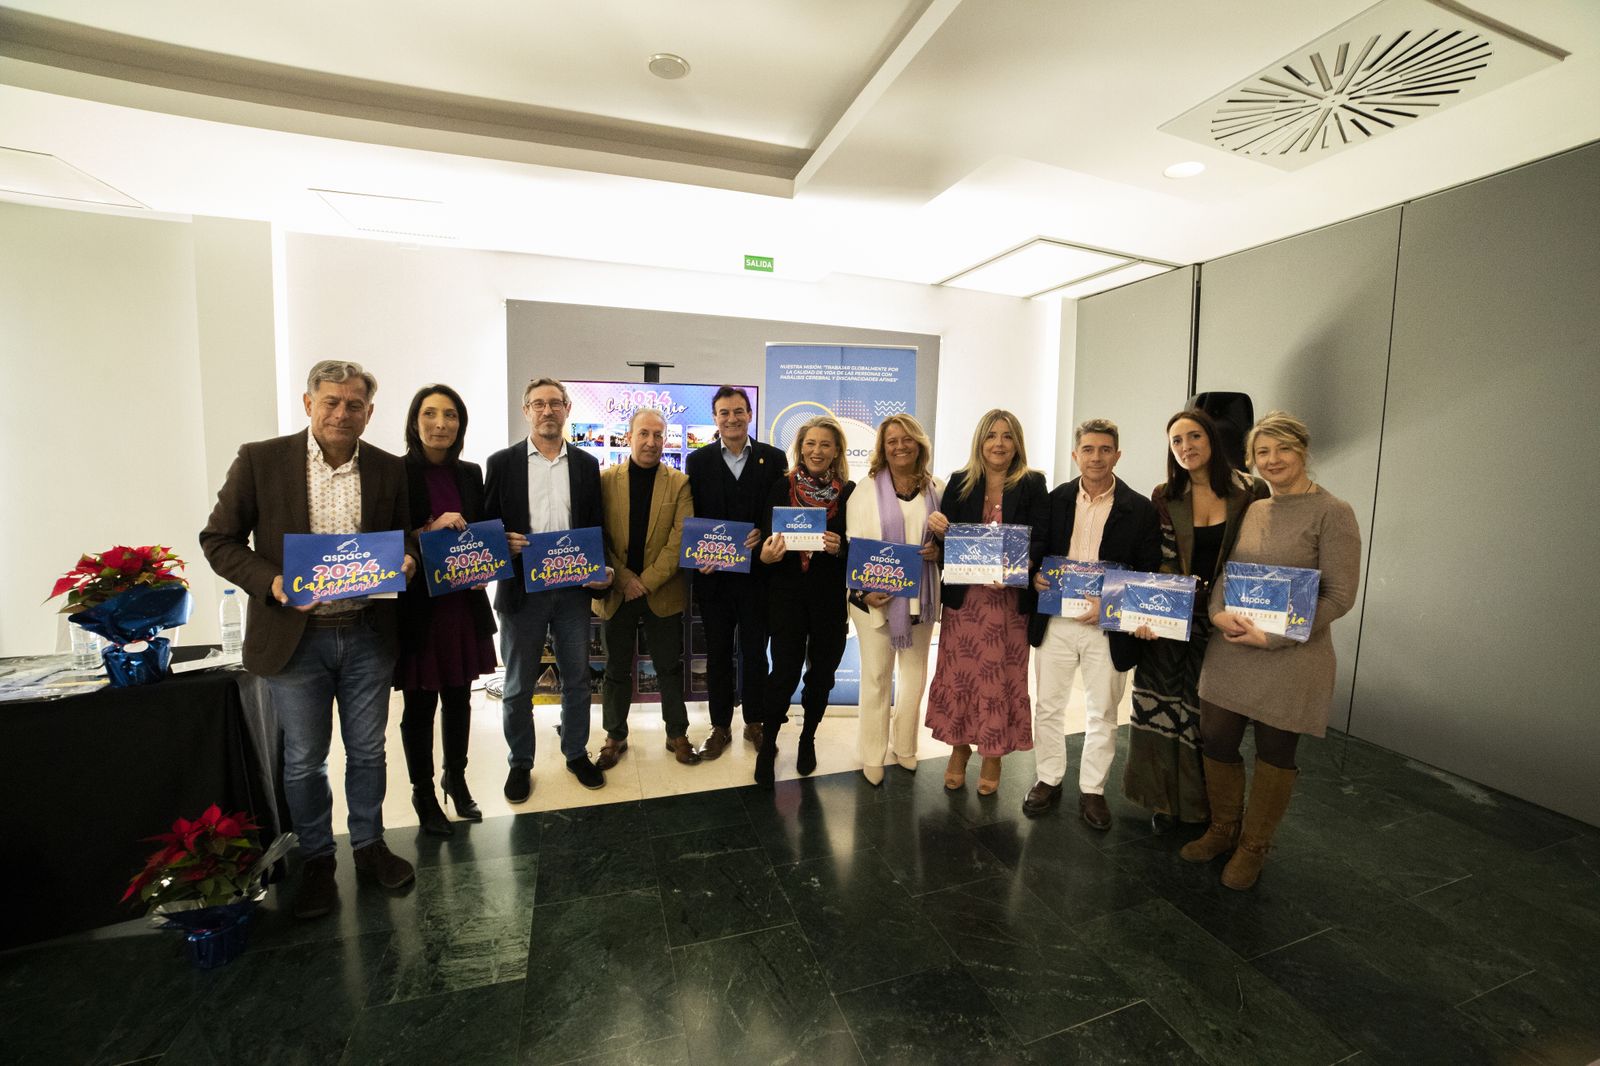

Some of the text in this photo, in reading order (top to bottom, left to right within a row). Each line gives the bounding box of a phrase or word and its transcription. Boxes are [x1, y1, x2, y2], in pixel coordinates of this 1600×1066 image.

[746, 259, 772, 268] SALIDA
[450, 541, 484, 553] aspace
[548, 546, 580, 555] aspace
[686, 547, 746, 563] Calendario
[697, 540, 736, 555] 2024
[323, 551, 371, 562] aspace
[445, 548, 493, 571] 2024
[542, 553, 587, 571] 2024
[870, 555, 900, 564] aspace
[312, 559, 380, 581] 2024
[434, 559, 506, 583] Calendario
[531, 563, 601, 581] Calendario
[863, 562, 904, 579] 2024
[293, 569, 399, 592] Calendario
[852, 569, 915, 589] Calendario
[313, 581, 381, 600] Solidario
[1139, 603, 1171, 612] aspace
[1240, 596, 1270, 604] aspace
